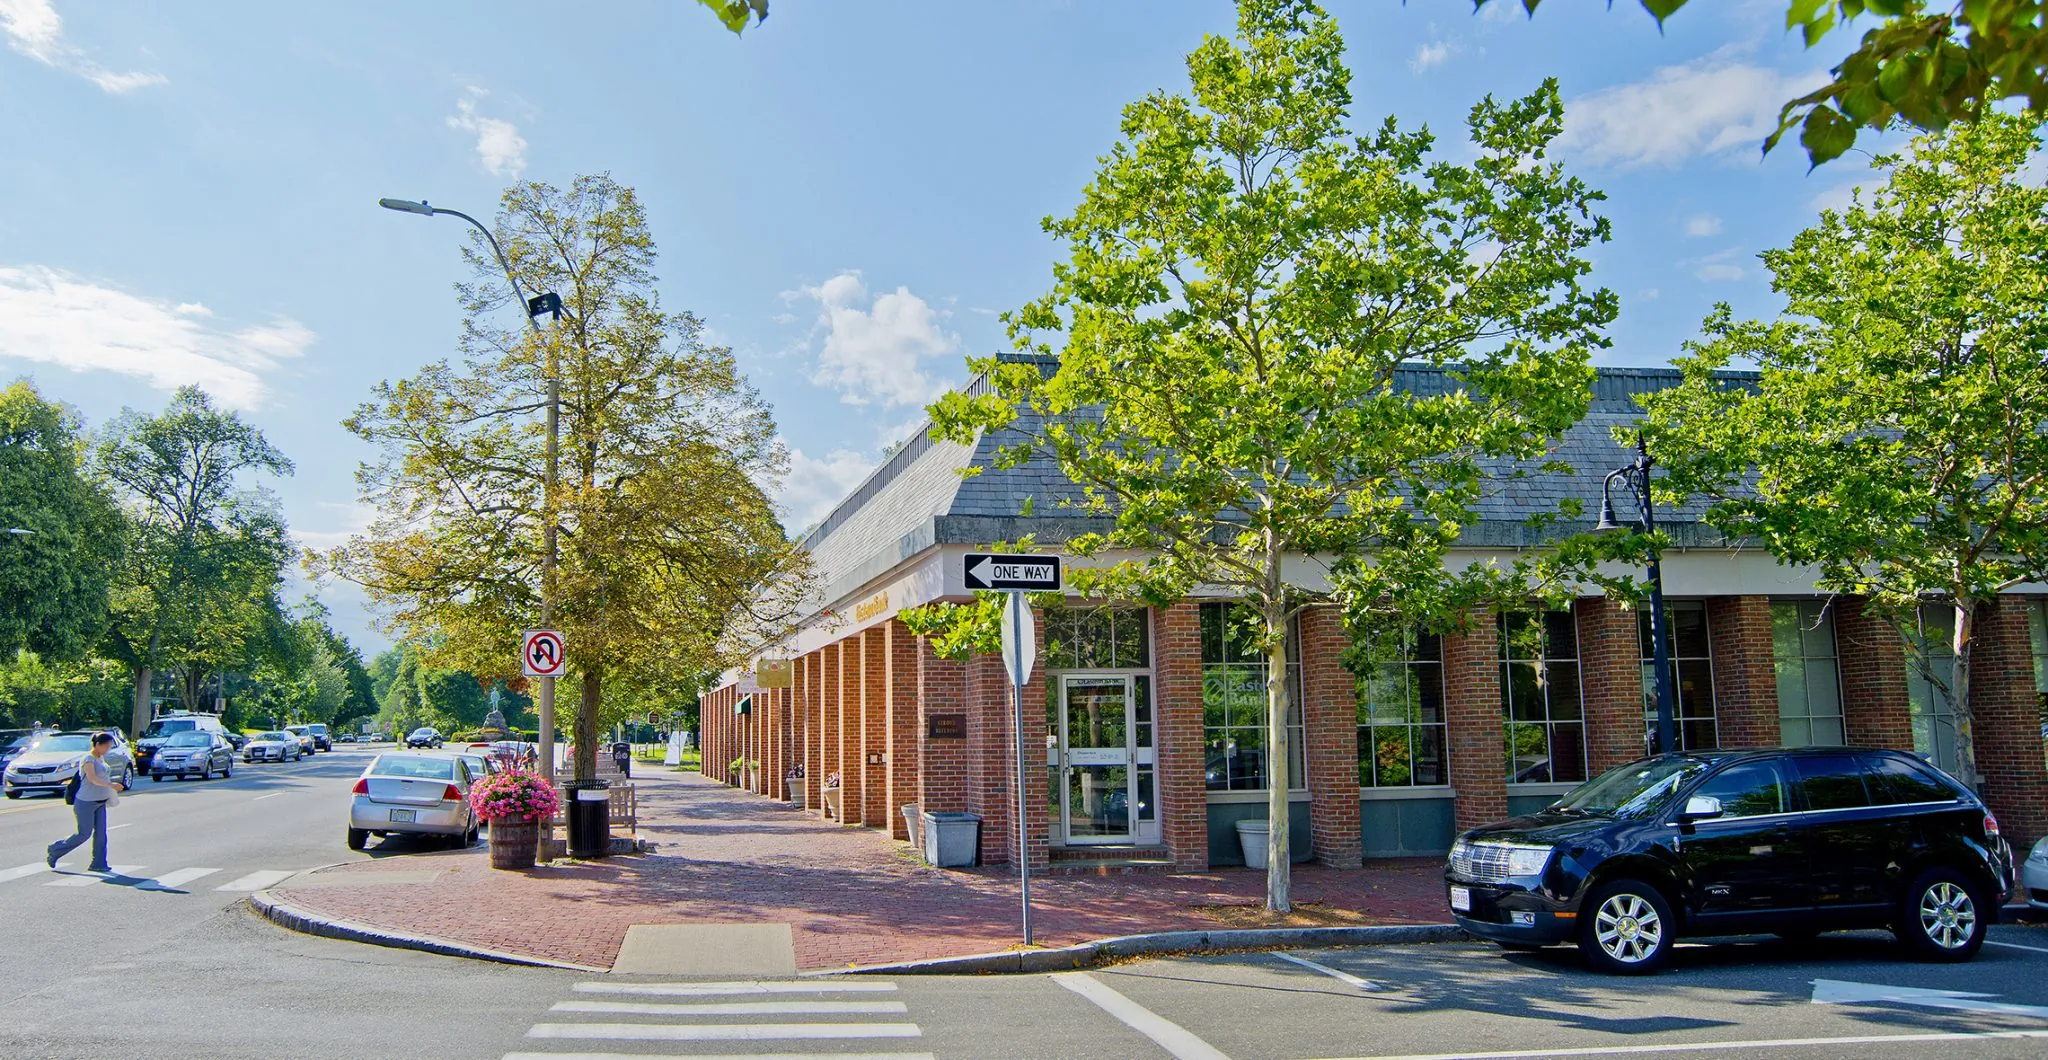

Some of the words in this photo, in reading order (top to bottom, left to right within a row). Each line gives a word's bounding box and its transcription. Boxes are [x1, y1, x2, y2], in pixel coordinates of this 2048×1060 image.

[993, 565, 1019, 579] ONE
[1024, 566, 1050, 579] WAY
[1711, 884, 1730, 895] MKX
